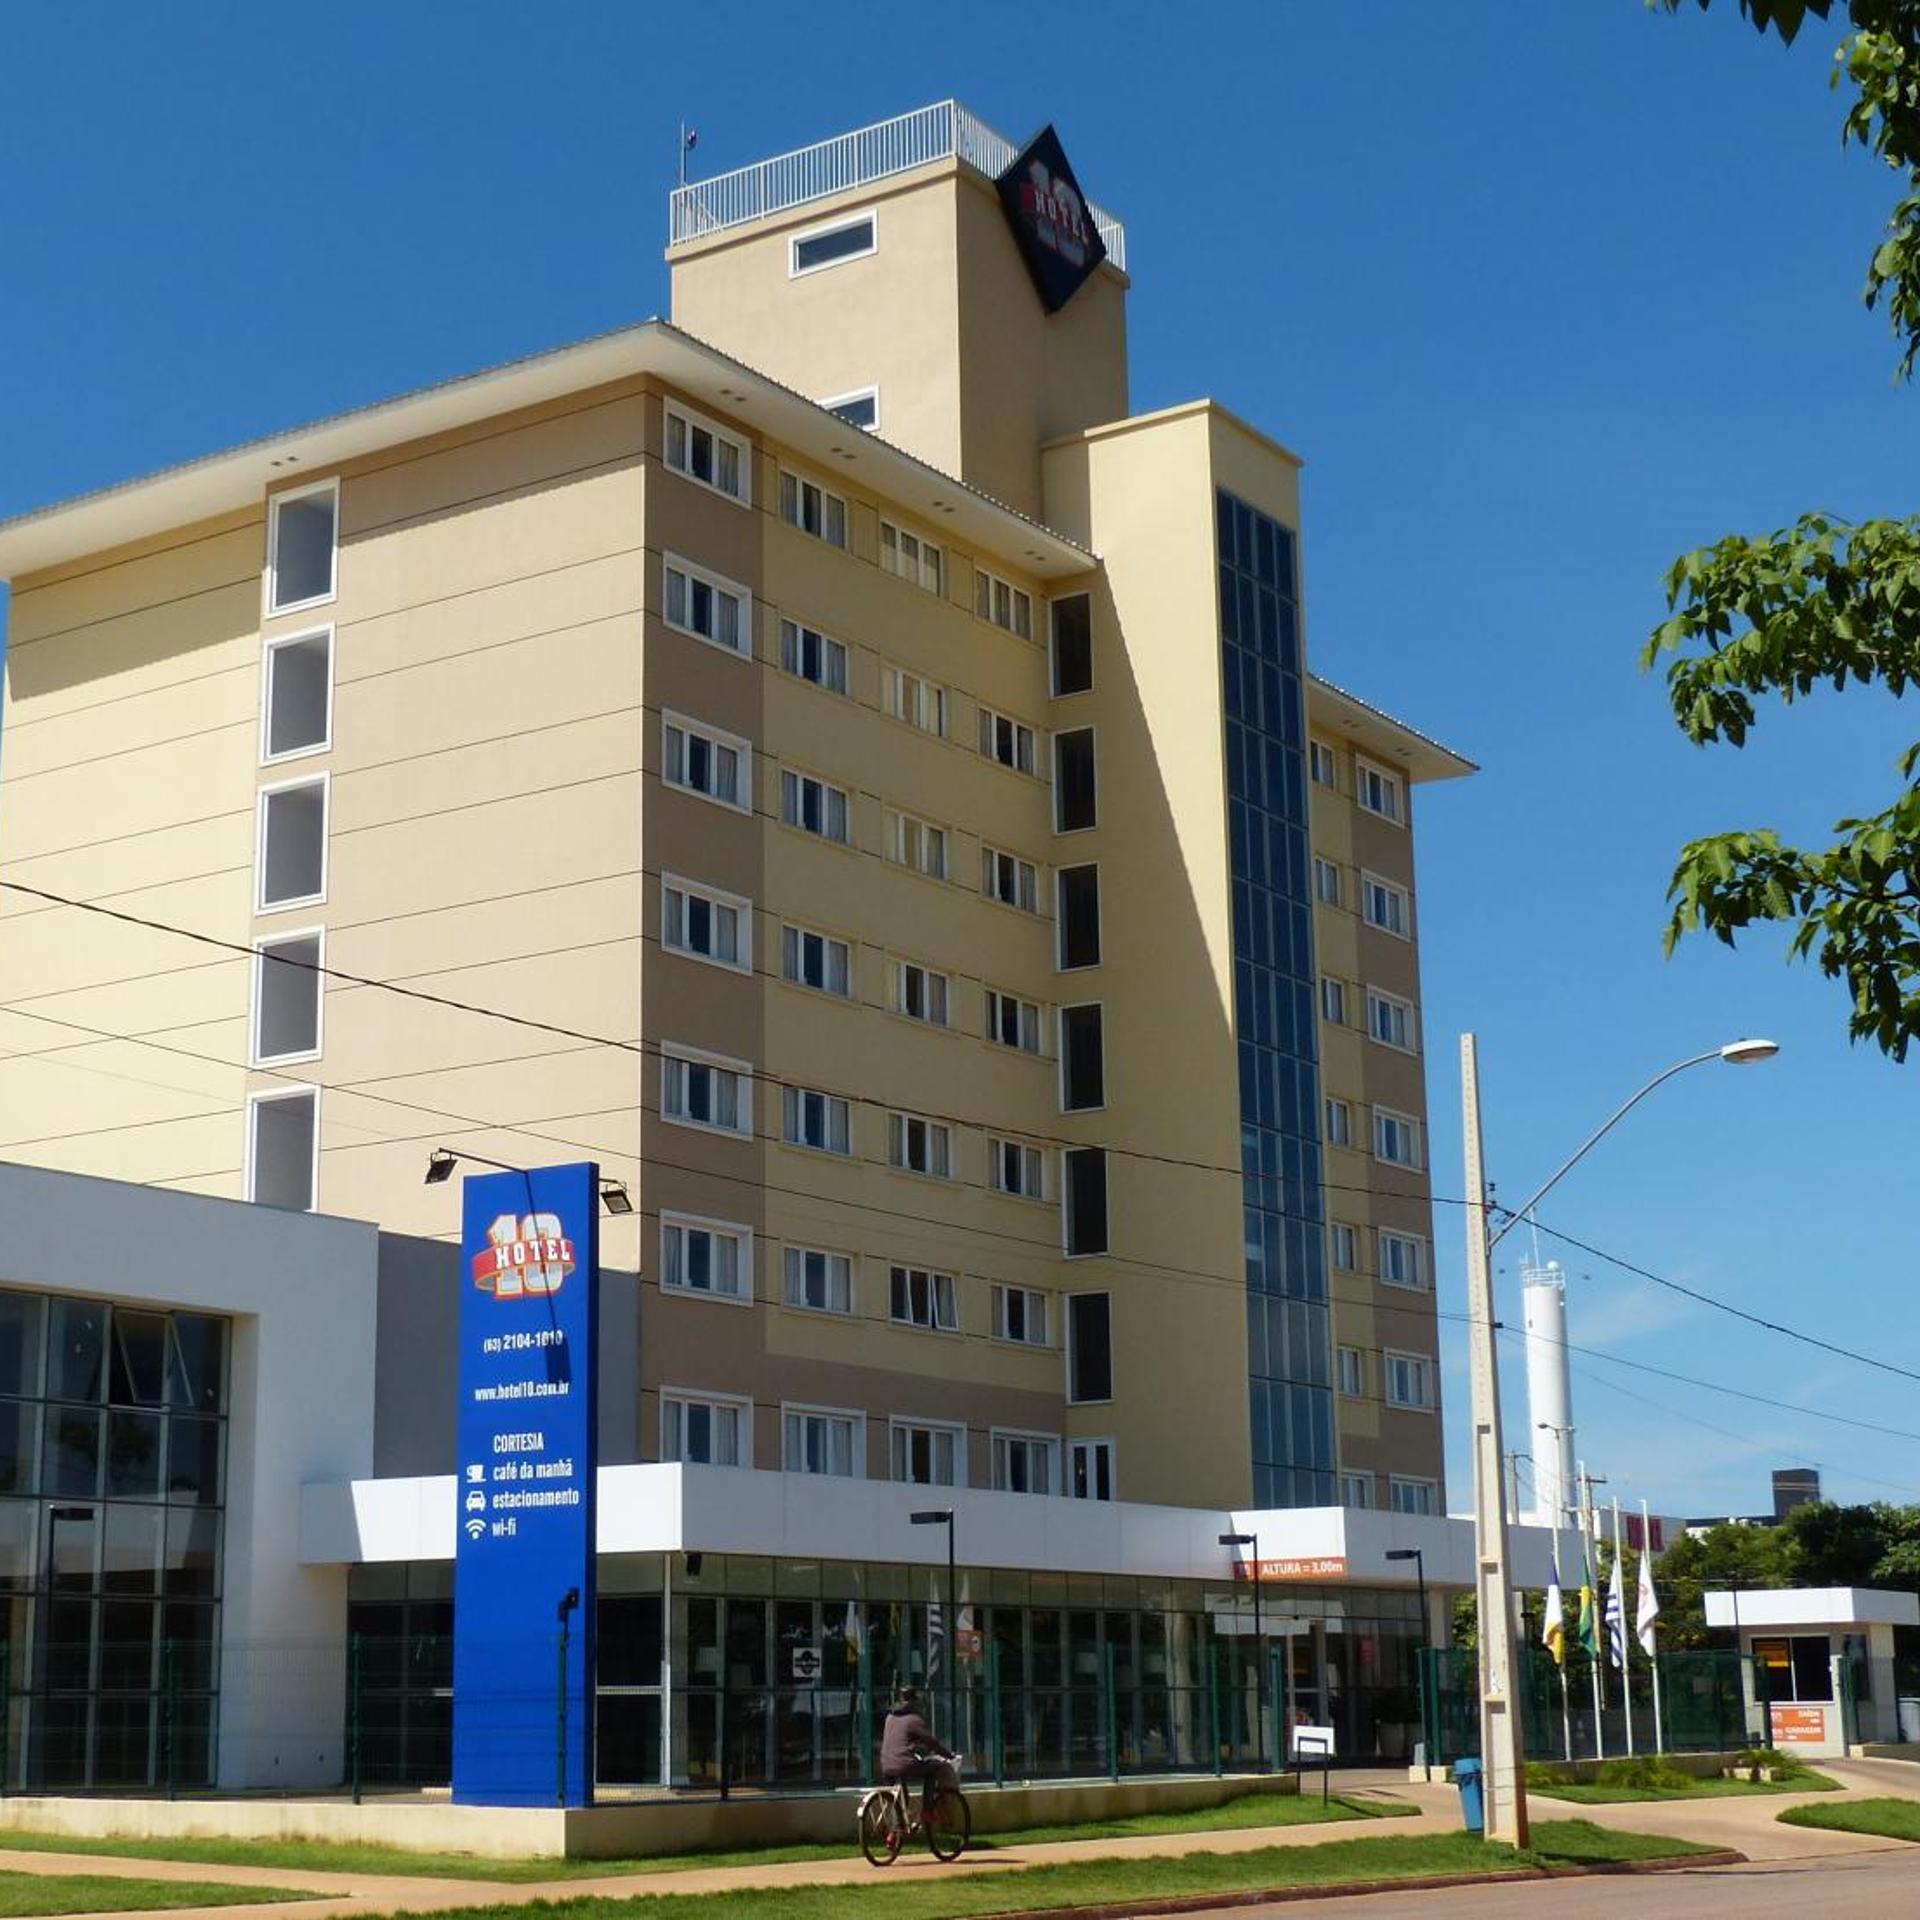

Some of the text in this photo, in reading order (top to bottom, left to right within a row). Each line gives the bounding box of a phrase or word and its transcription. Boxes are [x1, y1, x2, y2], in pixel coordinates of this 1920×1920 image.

[1033, 189, 1089, 246] HOTEL
[495, 1239, 570, 1270] HOTEL
[502, 1330, 563, 1350] 2104-1010
[474, 1380, 569, 1401] www.hotel10.com.br
[493, 1432, 544, 1453] CORTESIA
[493, 1458, 573, 1480] café da manhã
[492, 1487, 579, 1509] estacionamento
[492, 1517, 517, 1537] wi-fi
[1261, 1562, 1301, 1576] ALTURA
